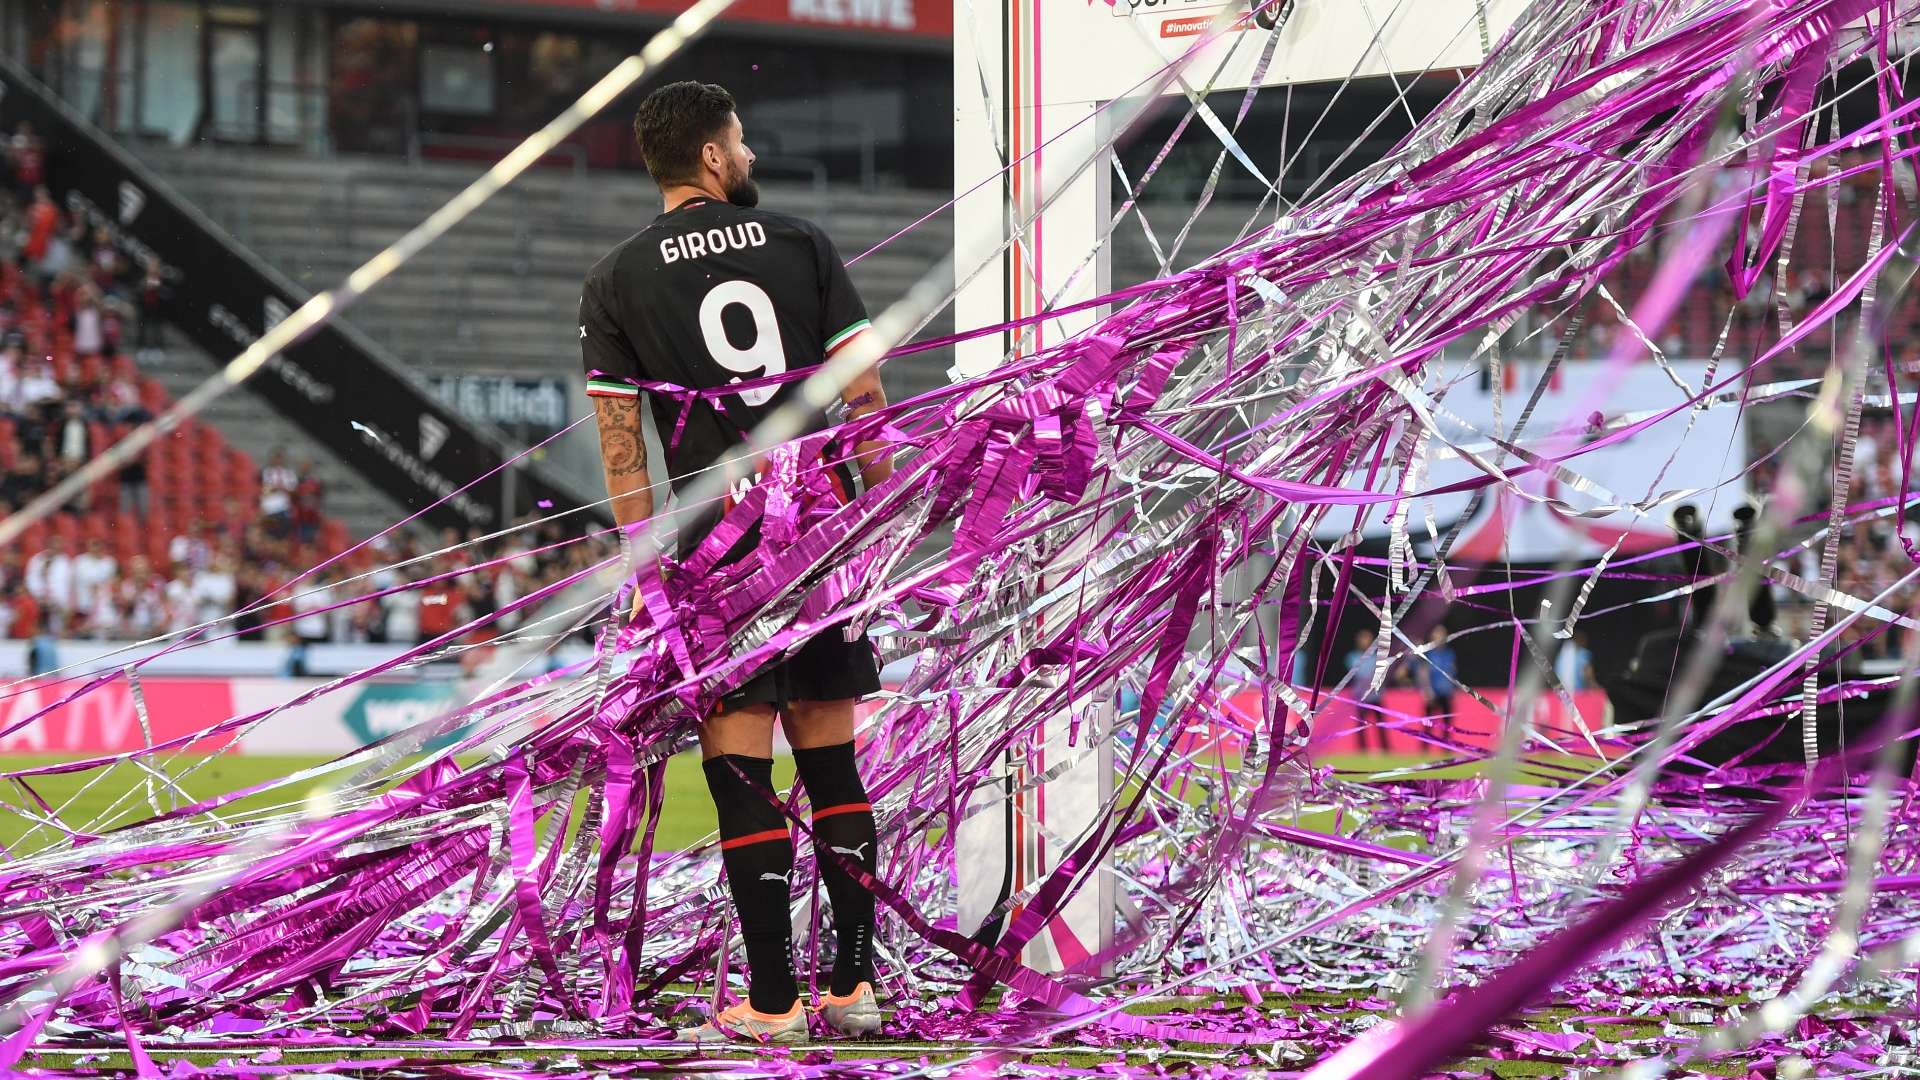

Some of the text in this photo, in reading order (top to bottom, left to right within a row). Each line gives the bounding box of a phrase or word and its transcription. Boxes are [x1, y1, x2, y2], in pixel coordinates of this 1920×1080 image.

[660, 222, 767, 264] GIROUD
[699, 280, 787, 407] 9
[0, 683, 47, 750] A
